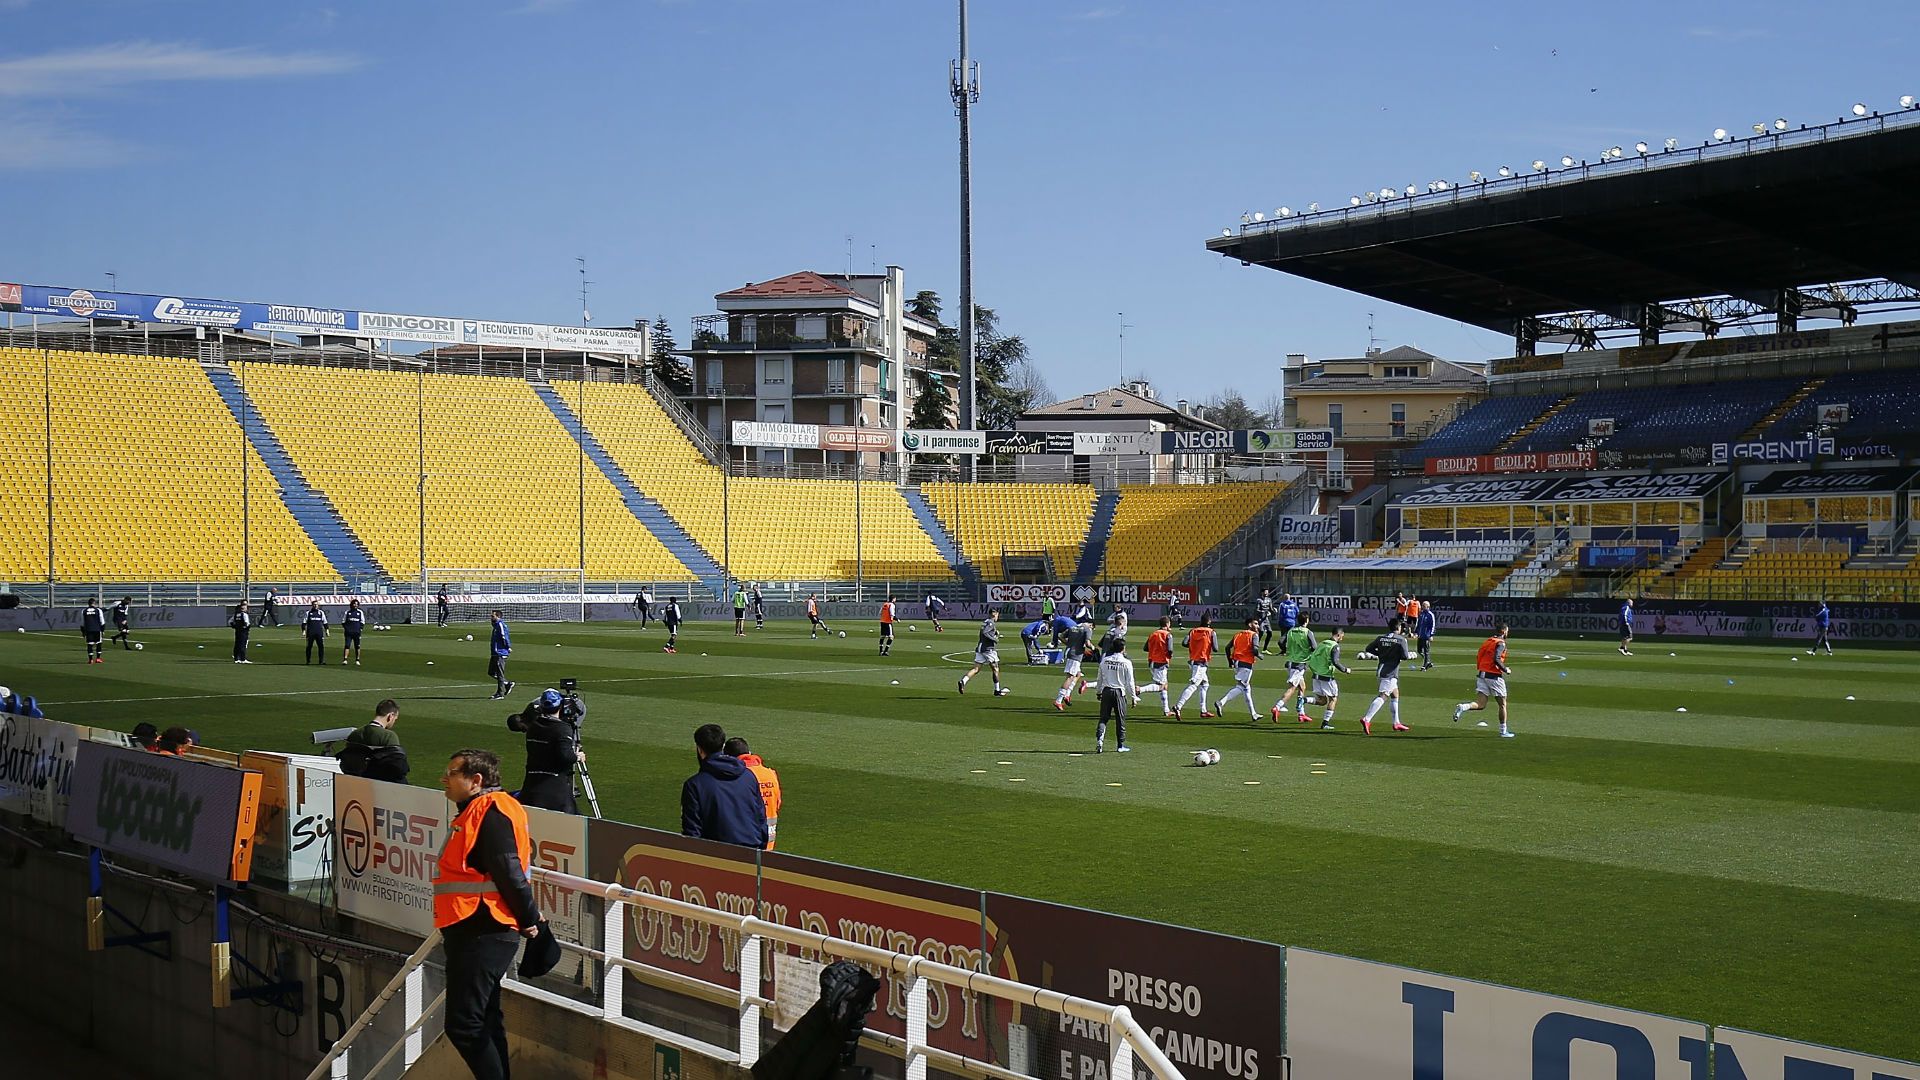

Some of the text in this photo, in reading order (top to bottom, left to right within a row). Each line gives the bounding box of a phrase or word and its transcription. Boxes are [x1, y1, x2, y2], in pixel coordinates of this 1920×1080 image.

[53, 296, 113, 309] EUROAUTO
[362, 314, 455, 331] MINGORI
[481, 323, 534, 336] TECNOVETRO
[363, 329, 414, 339] ENGINEERING
[422, 333, 455, 341] BUILDING
[553, 327, 641, 339] CANTONI ASSICURATORI
[1736, 338, 1814, 353] PETITOT
[756, 422, 818, 435] IMMOBILIARE
[756, 432, 818, 444] PUNTO ZERO
[828, 433, 888, 446] OLD WILD WEST
[923, 434, 980, 449] il parmense
[1079, 435, 1134, 444] VALENTI
[1173, 431, 1235, 448] NEGRI
[1268, 433, 1294, 448] AB
[1297, 433, 1325, 441] Global
[986, 439, 1046, 454] Tramonti
[1297, 441, 1328, 449] Service
[1840, 445, 1893, 456] NOVOTEL
[1456, 479, 1547, 493] CANOVI
[1614, 473, 1718, 488] CANOVI
[1400, 490, 1530, 504] COPERTURE
[1553, 485, 1703, 499] COPERTURE
[279, 595, 346, 605] WAMPUM
[346, 595, 412, 605] WAMPUM
[1483, 603, 1528, 613] HOTELS
[1539, 604, 1592, 614] RESORTS
[1762, 606, 1900, 618] HOTELS RESORTS
[1535, 616, 1554, 629] DA
[1557, 616, 1620, 632] ESTERNO
[1715, 617, 1763, 632] Mondo
[1768, 617, 1806, 633] Verde
[373, 806, 440, 849] FIRST
[374, 842, 441, 884] POINT
[341, 876, 433, 912] WWW.FIRSTPOINT.I
[631, 875, 711, 965] OLD
[1107, 967, 1202, 1018] PRESSO
[316, 954, 345, 1055] B
[1058, 1012, 1110, 1045] PAR
[1148, 1026, 1260, 1080] CAMPUS
[1060, 1050, 1072, 1080] E
